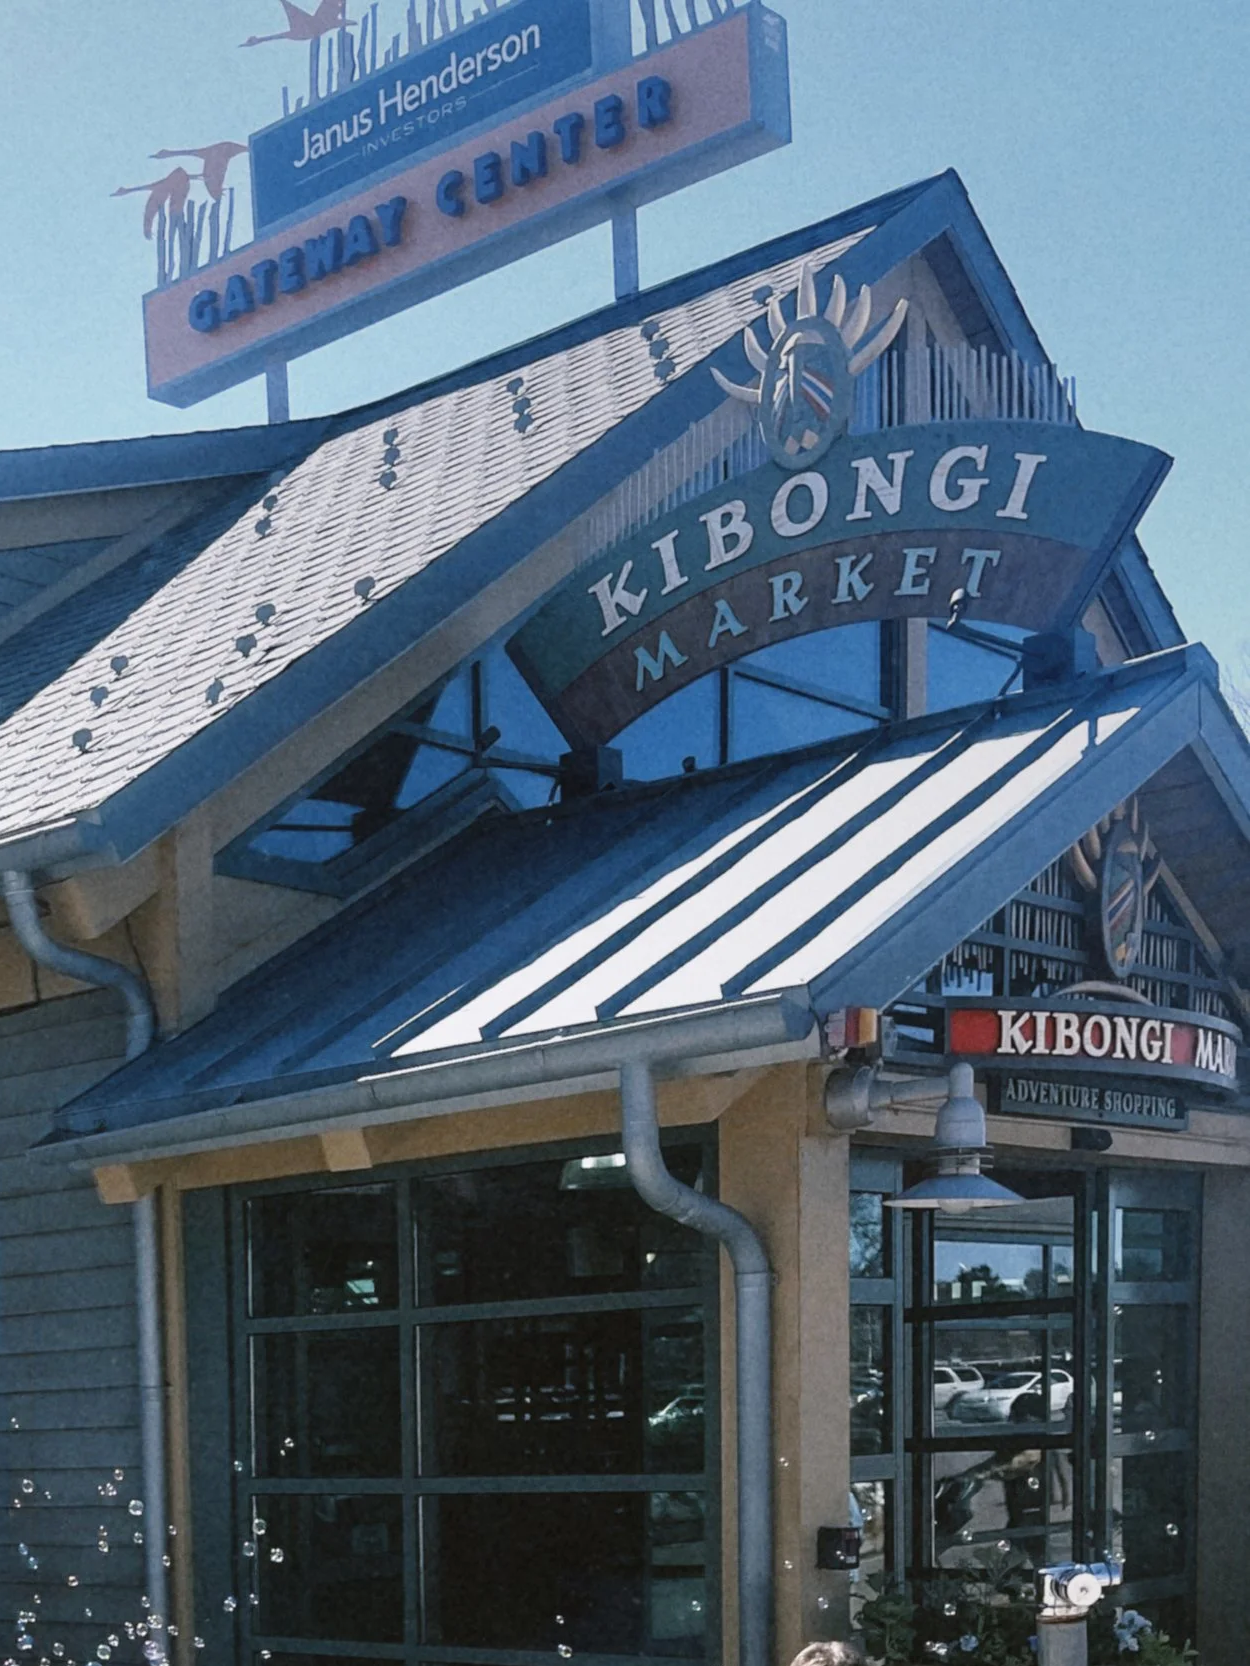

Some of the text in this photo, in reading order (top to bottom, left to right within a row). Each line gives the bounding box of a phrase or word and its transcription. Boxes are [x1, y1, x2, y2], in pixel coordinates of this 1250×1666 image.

[293, 24, 541, 168] Janus Henderson
[361, 95, 468, 157] INVESTORS
[188, 75, 672, 333] GATEWAY CENTER
[587, 443, 1048, 637] KIBONGI
[632, 546, 1001, 692] MARKET
[996, 1009, 1238, 1080] KIBONGI MAR
[1005, 1077, 1177, 1119] ADVENTURE SHOPPING
